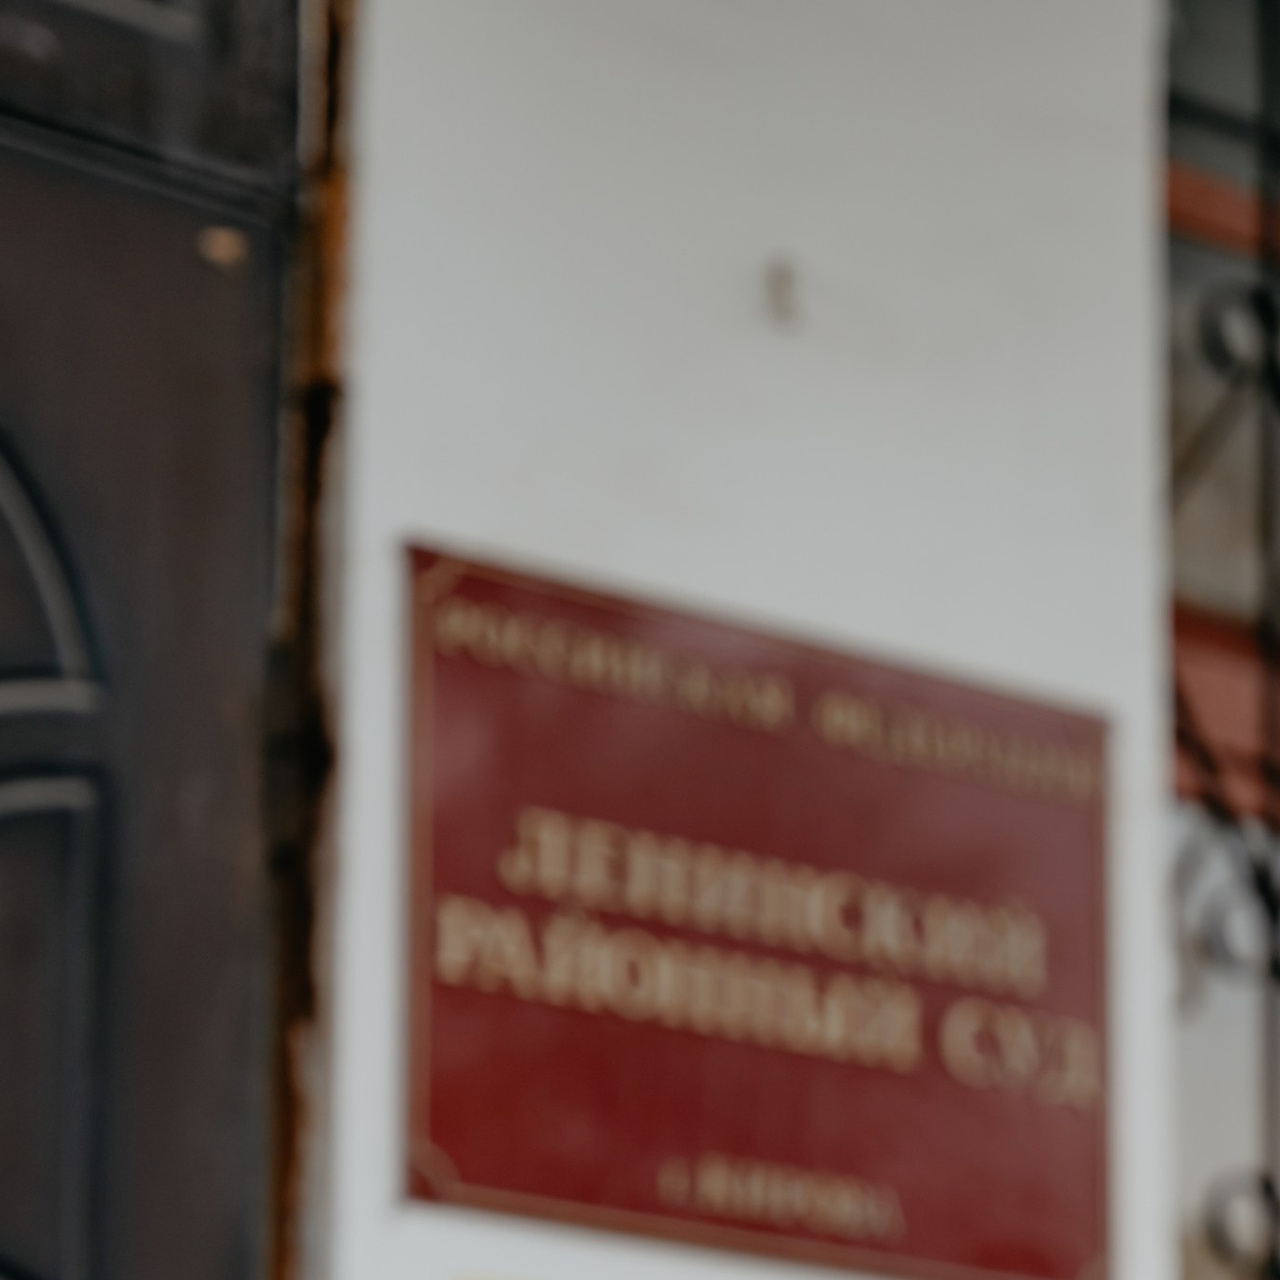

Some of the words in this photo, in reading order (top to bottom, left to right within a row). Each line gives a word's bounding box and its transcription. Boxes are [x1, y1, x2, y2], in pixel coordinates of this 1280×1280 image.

[436, 895, 921, 1072] РАЙОННЫЙ
[942, 999, 1099, 1108] СУД
[500, 808, 1046, 997] ЛЕНИНСКИЙ
